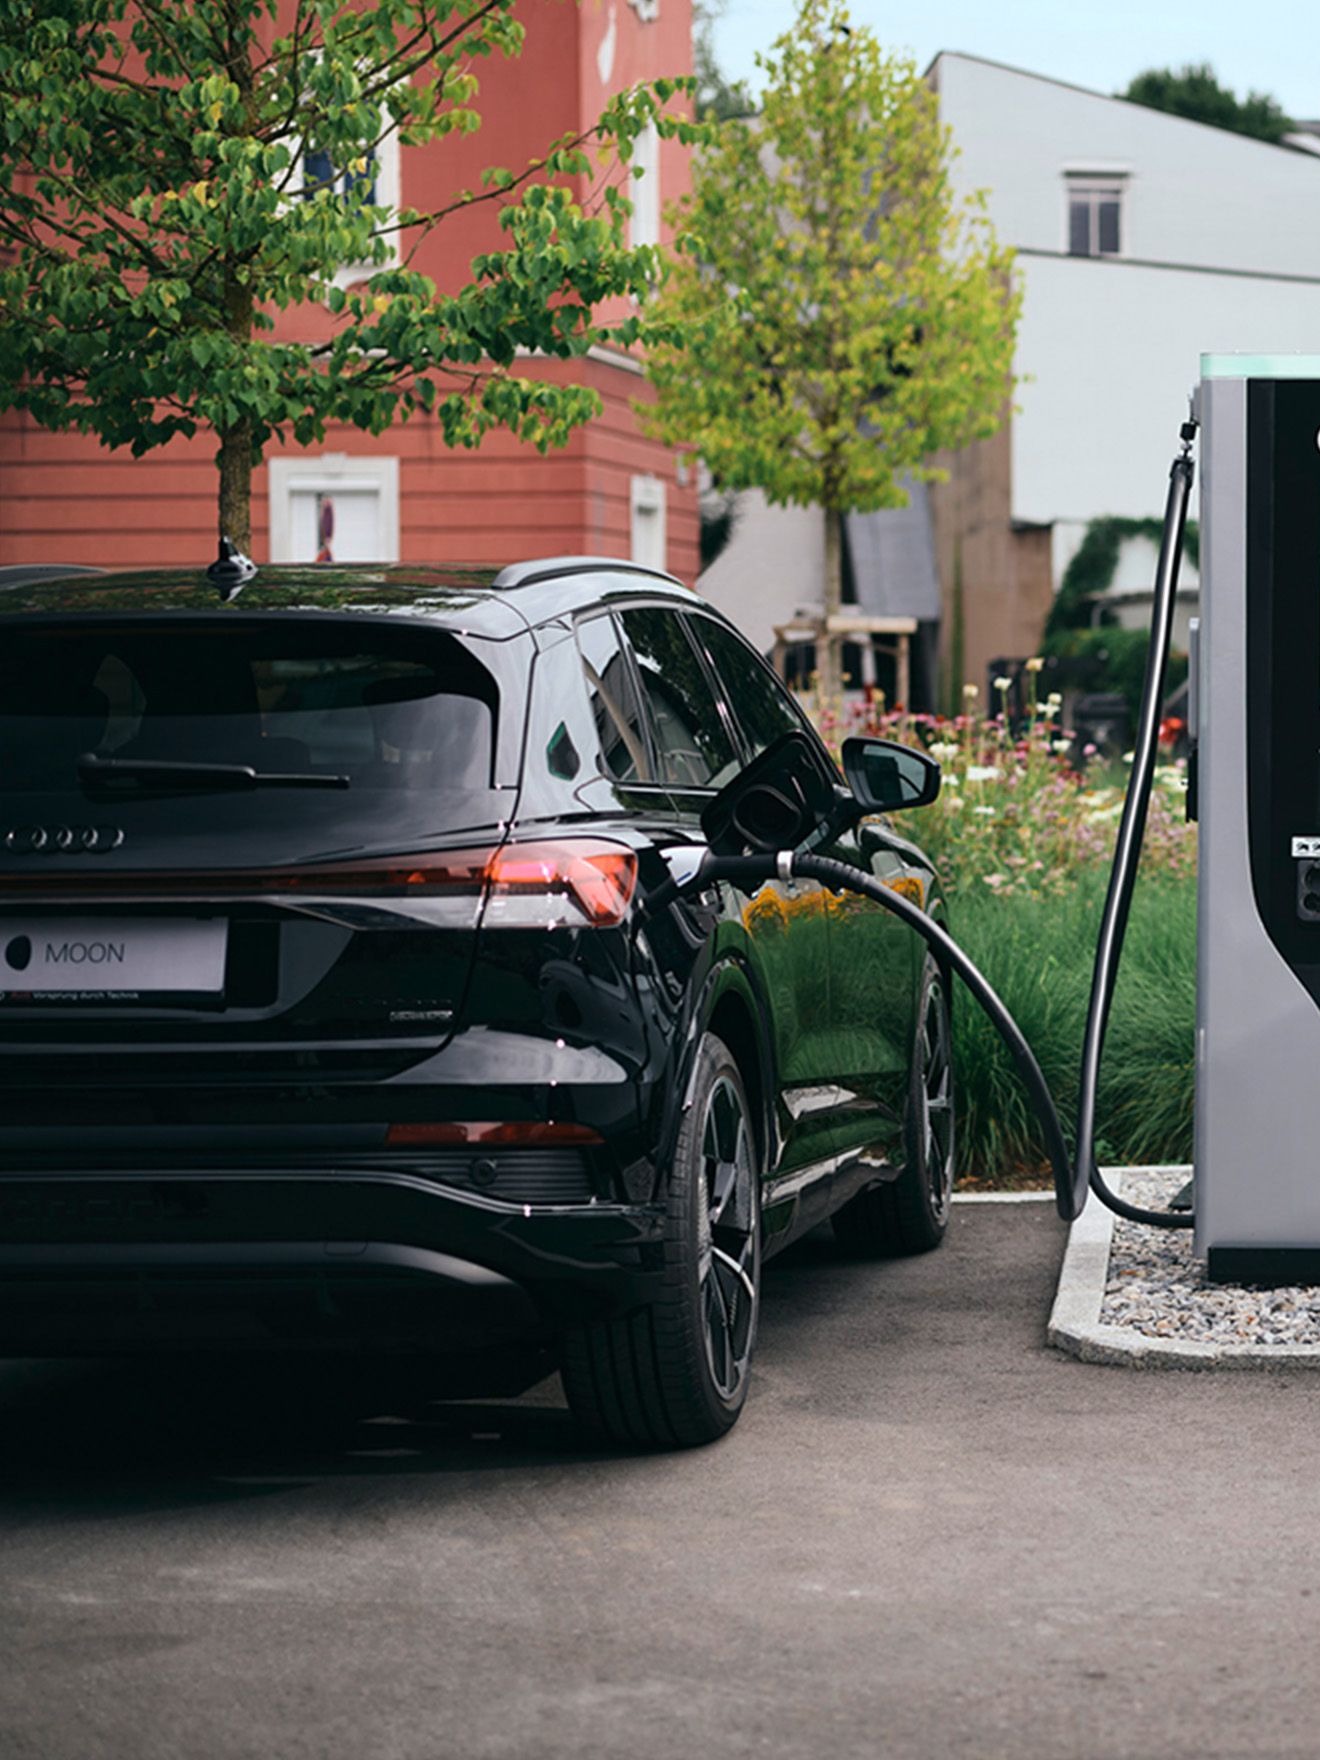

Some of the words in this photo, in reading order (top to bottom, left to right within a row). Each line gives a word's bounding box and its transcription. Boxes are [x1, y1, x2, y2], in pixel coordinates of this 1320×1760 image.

[45, 942, 125, 963] MOON
[33, 990, 78, 1000] Vorsprung
[80, 990, 104, 999] durch
[106, 990, 139, 999] Technik
